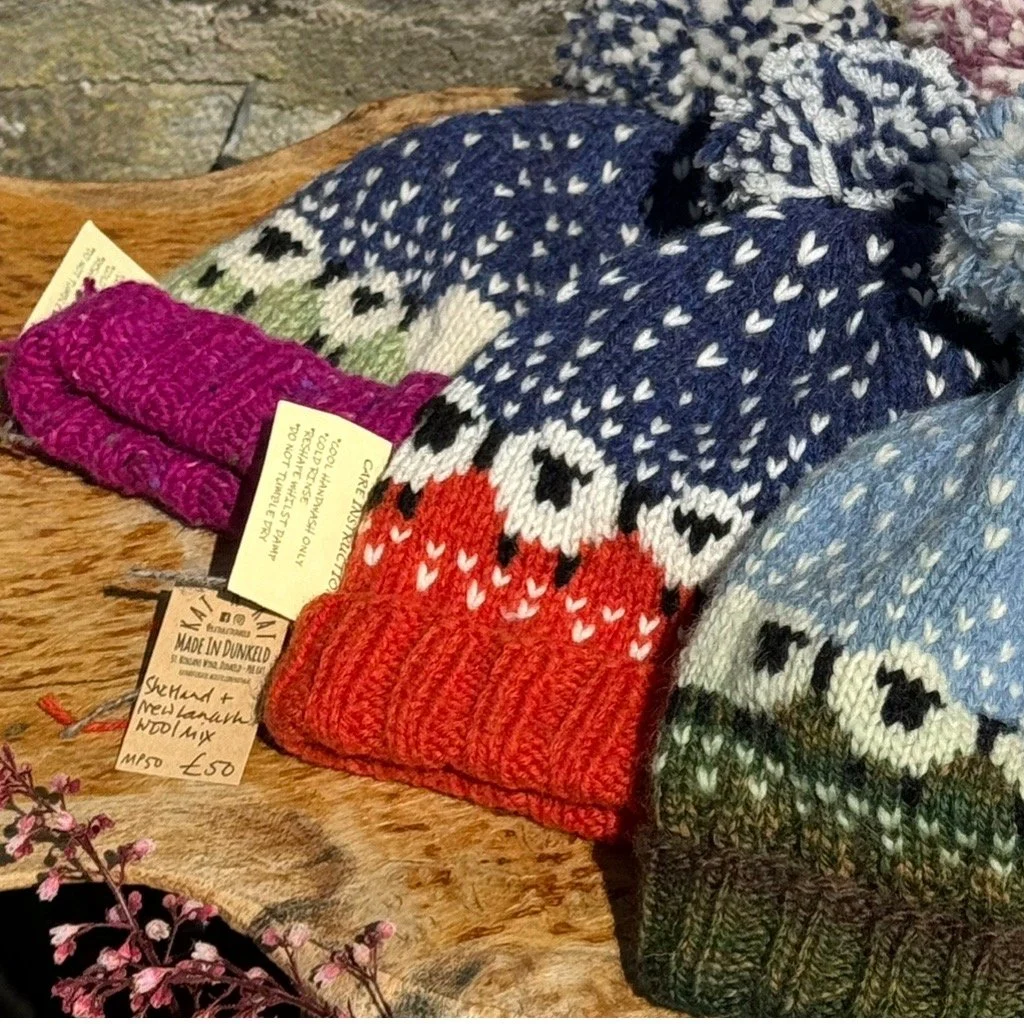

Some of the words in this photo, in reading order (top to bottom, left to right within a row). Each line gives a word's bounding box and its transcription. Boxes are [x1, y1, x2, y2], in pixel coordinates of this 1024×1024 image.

[282, 443, 293, 468] NOT
[300, 467, 319, 505] RINSE
[355, 458, 374, 498] CARE
[266, 471, 287, 519] TUMBLE
[280, 481, 298, 528] WHILST
[305, 473, 331, 536] HANDWASH
[259, 520, 272, 542] DRY
[268, 529, 285, 562] DAMP
[325, 498, 362, 593] INSTRUCTIO
[295, 536, 311, 567] ONLY
[180, 595, 213, 631] KAT
[174, 632, 205, 655] MADE
[144, 674, 215, 703] Shetland
[175, 705, 250, 725] Lanark
[120, 753, 162, 769] MP50
[179, 752, 235, 777] £50
